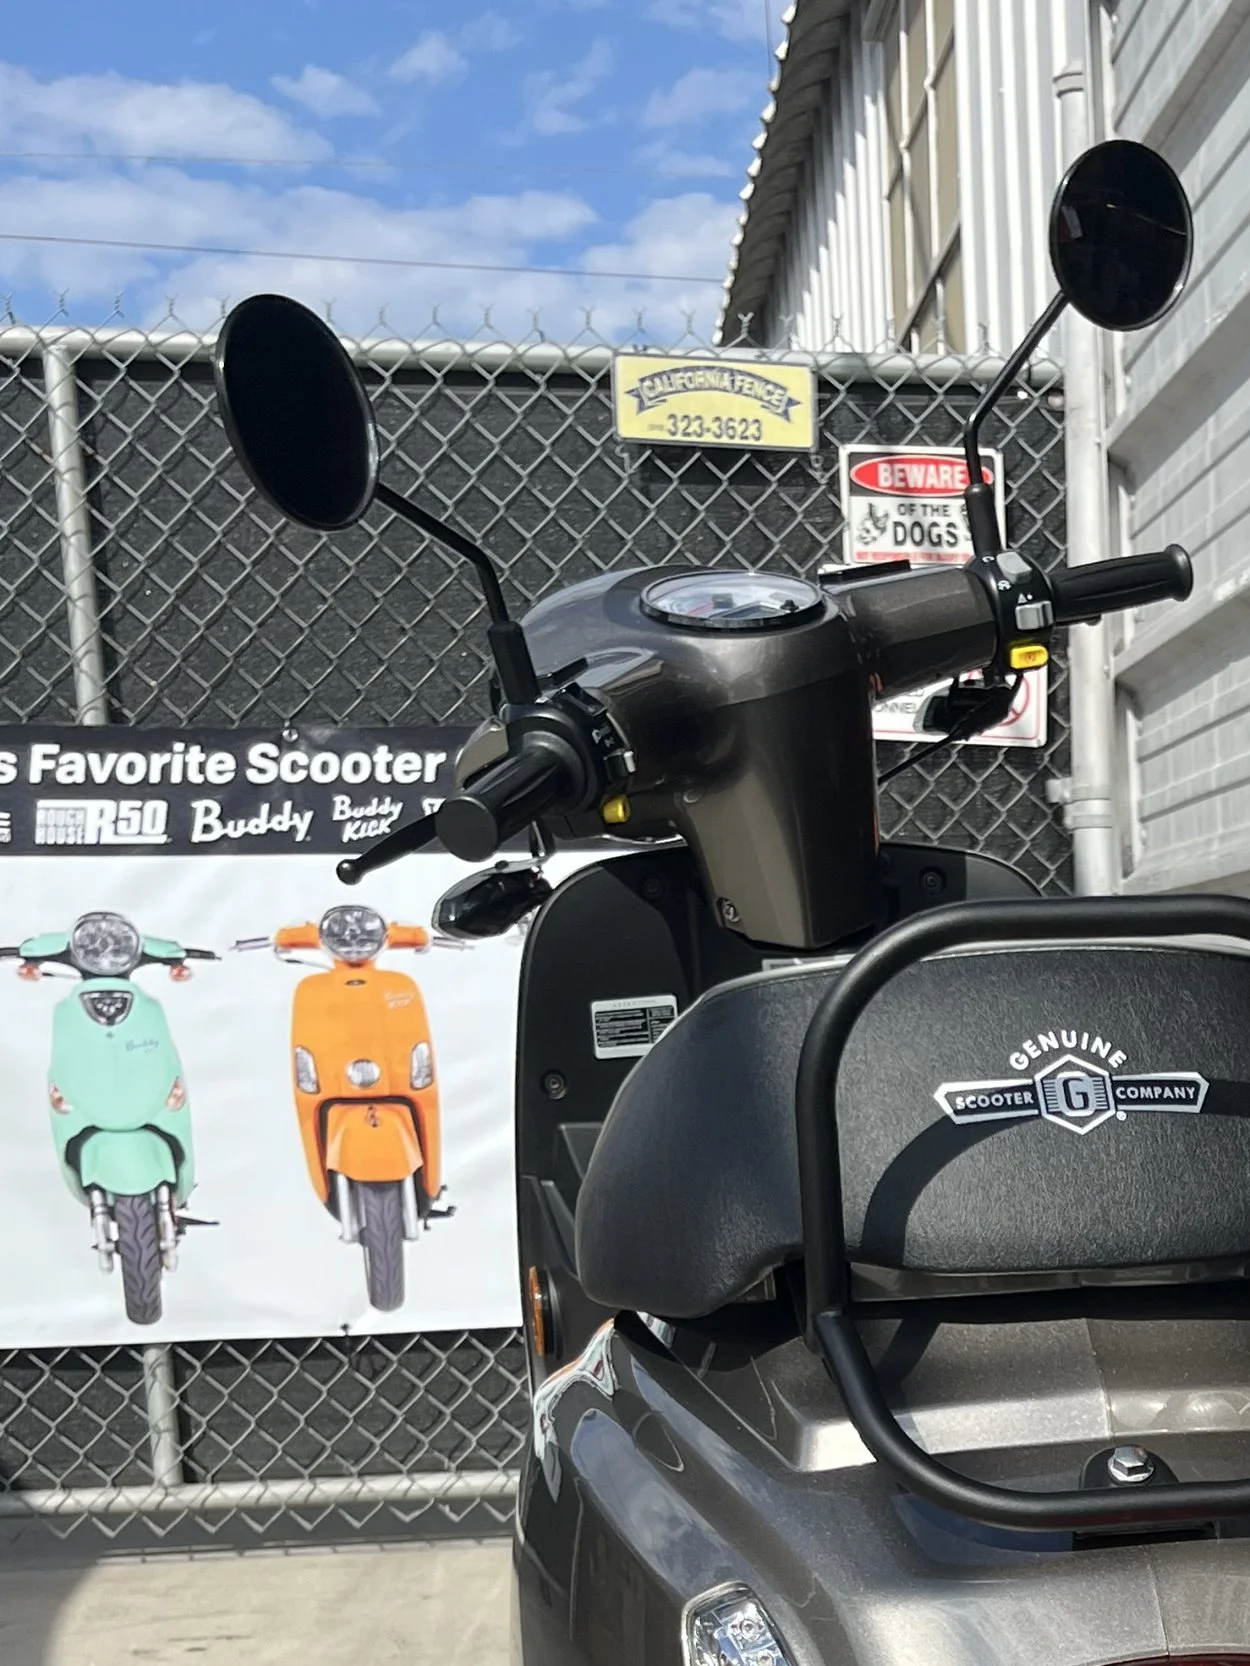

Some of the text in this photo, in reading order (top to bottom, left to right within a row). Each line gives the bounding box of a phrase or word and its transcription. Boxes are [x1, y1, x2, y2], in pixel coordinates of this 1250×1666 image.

[641, 368, 786, 407] CALIFORNIA FENCE
[667, 413, 763, 441] 323-3623
[876, 462, 965, 489] BEWARE
[897, 502, 950, 517] OF THE
[893, 520, 959, 547] DOGS
[29, 742, 237, 785] Favorite
[246, 743, 447, 784] Scooter
[191, 799, 314, 843] Buddy
[332, 794, 402, 822] Buddy
[1009, 1030, 1128, 1070] GENUINE
[955, 1075, 1196, 1113] SCOOTER G COMPANY
